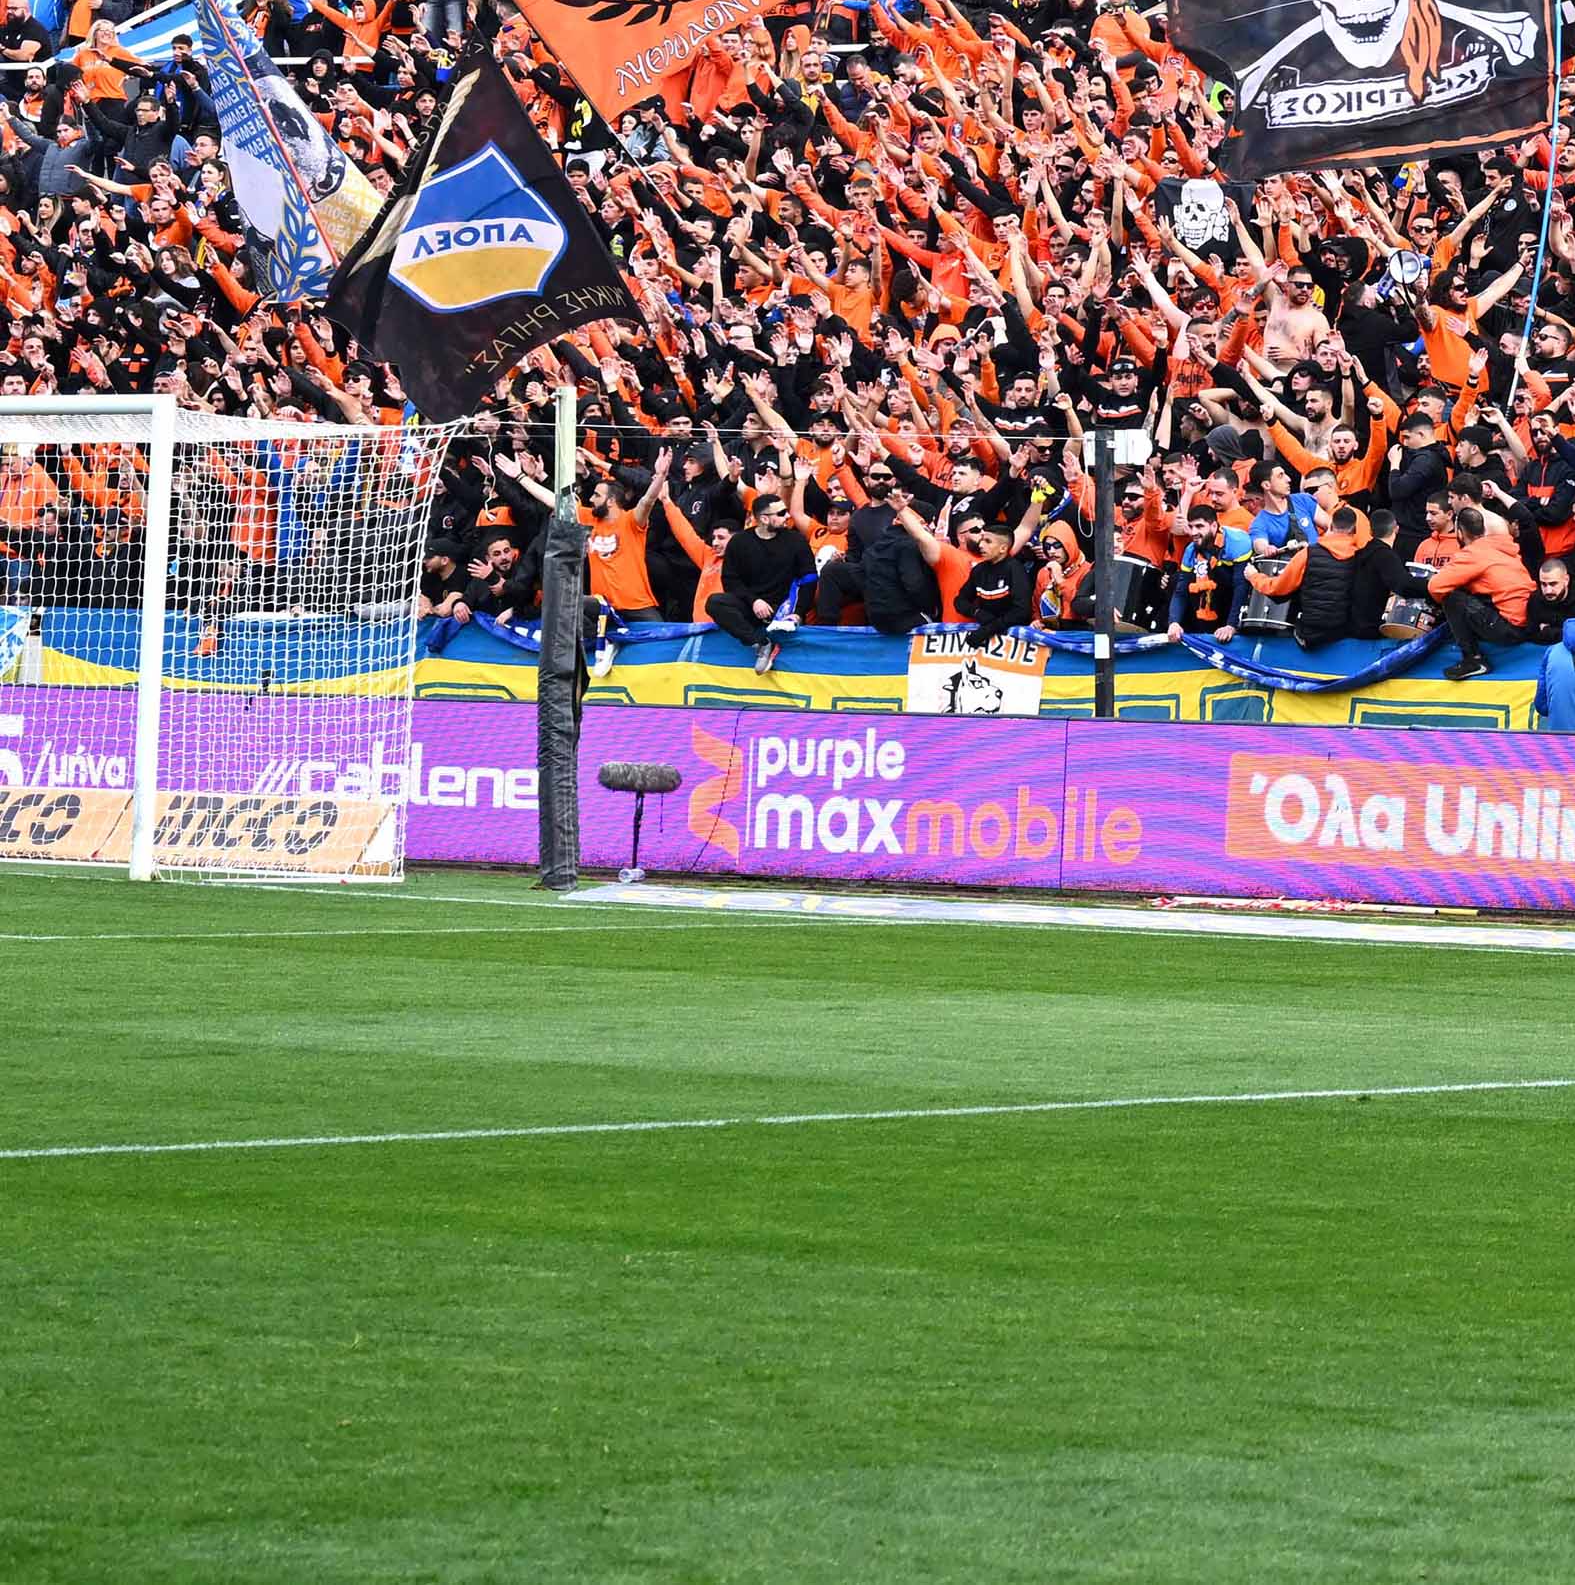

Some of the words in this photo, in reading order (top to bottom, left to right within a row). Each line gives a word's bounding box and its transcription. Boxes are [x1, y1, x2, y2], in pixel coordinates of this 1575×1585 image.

[299, 741, 539, 809] cablene
[757, 727, 906, 790] purple
[753, 785, 1143, 865] maxmobile
